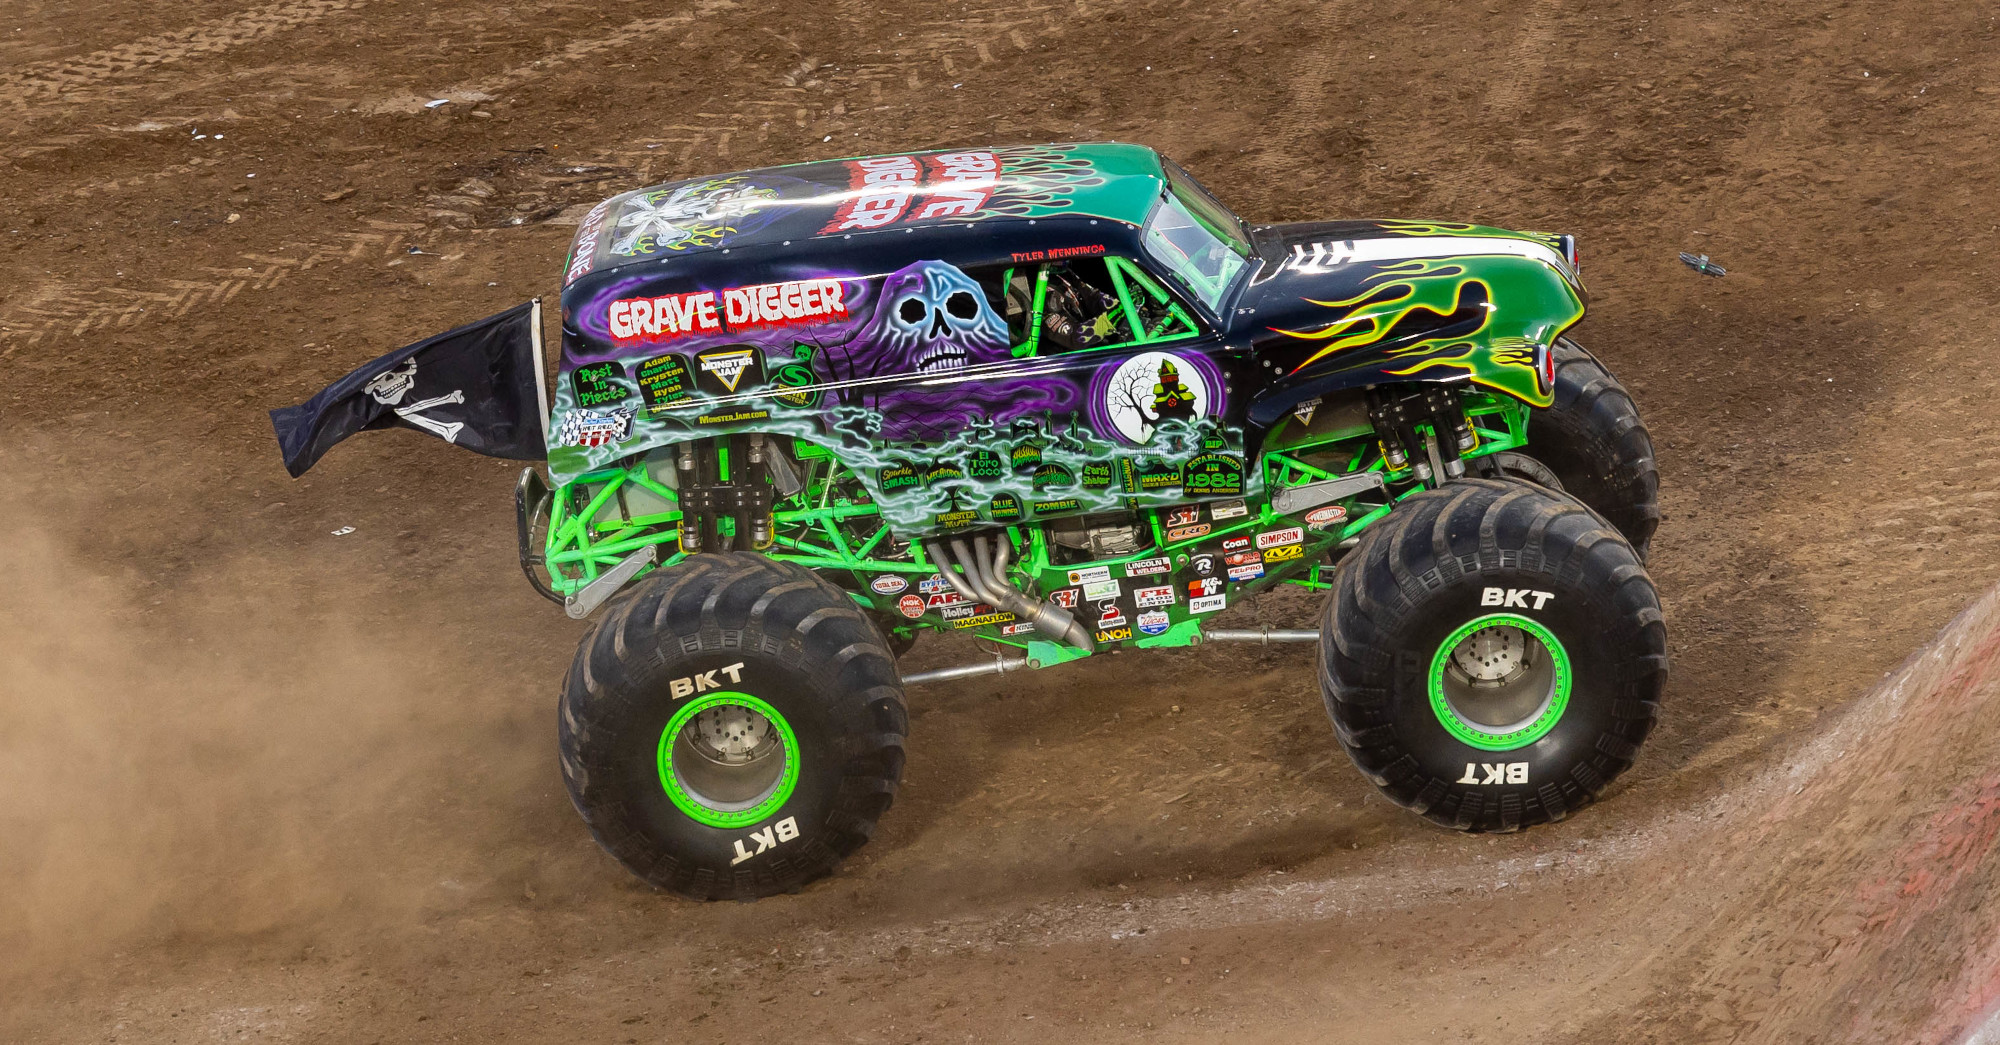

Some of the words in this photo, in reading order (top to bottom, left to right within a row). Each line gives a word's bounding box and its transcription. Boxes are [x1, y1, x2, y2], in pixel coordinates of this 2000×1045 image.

[918, 152, 996, 218] GRAVE
[838, 156, 919, 229] DIGGER
[1011, 251, 1044, 263] TYLER
[1048, 244, 1105, 259] MENNINGA
[609, 291, 720, 338] GRAVE
[724, 281, 845, 324] DIGGER
[641, 361, 676, 377] Charlie
[644, 355, 671, 369] Adam
[701, 357, 753, 371] MONSTER
[579, 364, 613, 382] Rest
[640, 367, 684, 386] Krysten
[718, 367, 743, 376] JAM
[651, 375, 680, 390] Matt
[580, 387, 627, 406] Pieces
[653, 384, 682, 398] Ryan
[654, 391, 684, 404] Tyler
[1205, 440, 1223, 449] RIP
[1187, 454, 1241, 470] ESTABLISHED
[1205, 464, 1220, 472] IN
[882, 467, 912, 481] Sparkle
[1084, 466, 1109, 476] Earth
[1141, 472, 1179, 483] MAX-D
[883, 477, 918, 490] SMASH
[1083, 476, 1110, 485] Shaker
[1186, 473, 1241, 487] 1982
[993, 500, 1014, 509] BLUE
[1035, 500, 1078, 511] ZOMBIE
[937, 510, 977, 522] MONSTER
[992, 508, 1019, 517] THUNDER
[945, 520, 970, 528] MUTT
[1223, 539, 1248, 549] Coan
[1260, 530, 1299, 545] SIMPSON
[1128, 559, 1162, 570] LINCOLN
[1141, 588, 1171, 598] FK
[1481, 587, 1555, 610] BKT
[1201, 599, 1222, 608] OPTIMA
[942, 607, 975, 618] Holley
[954, 613, 1015, 628] MAGNAFLOW
[1096, 627, 1132, 642] UNOH
[669, 662, 744, 700] BKT
[1456, 762, 1529, 785] BKT
[729, 816, 800, 867] BKT
